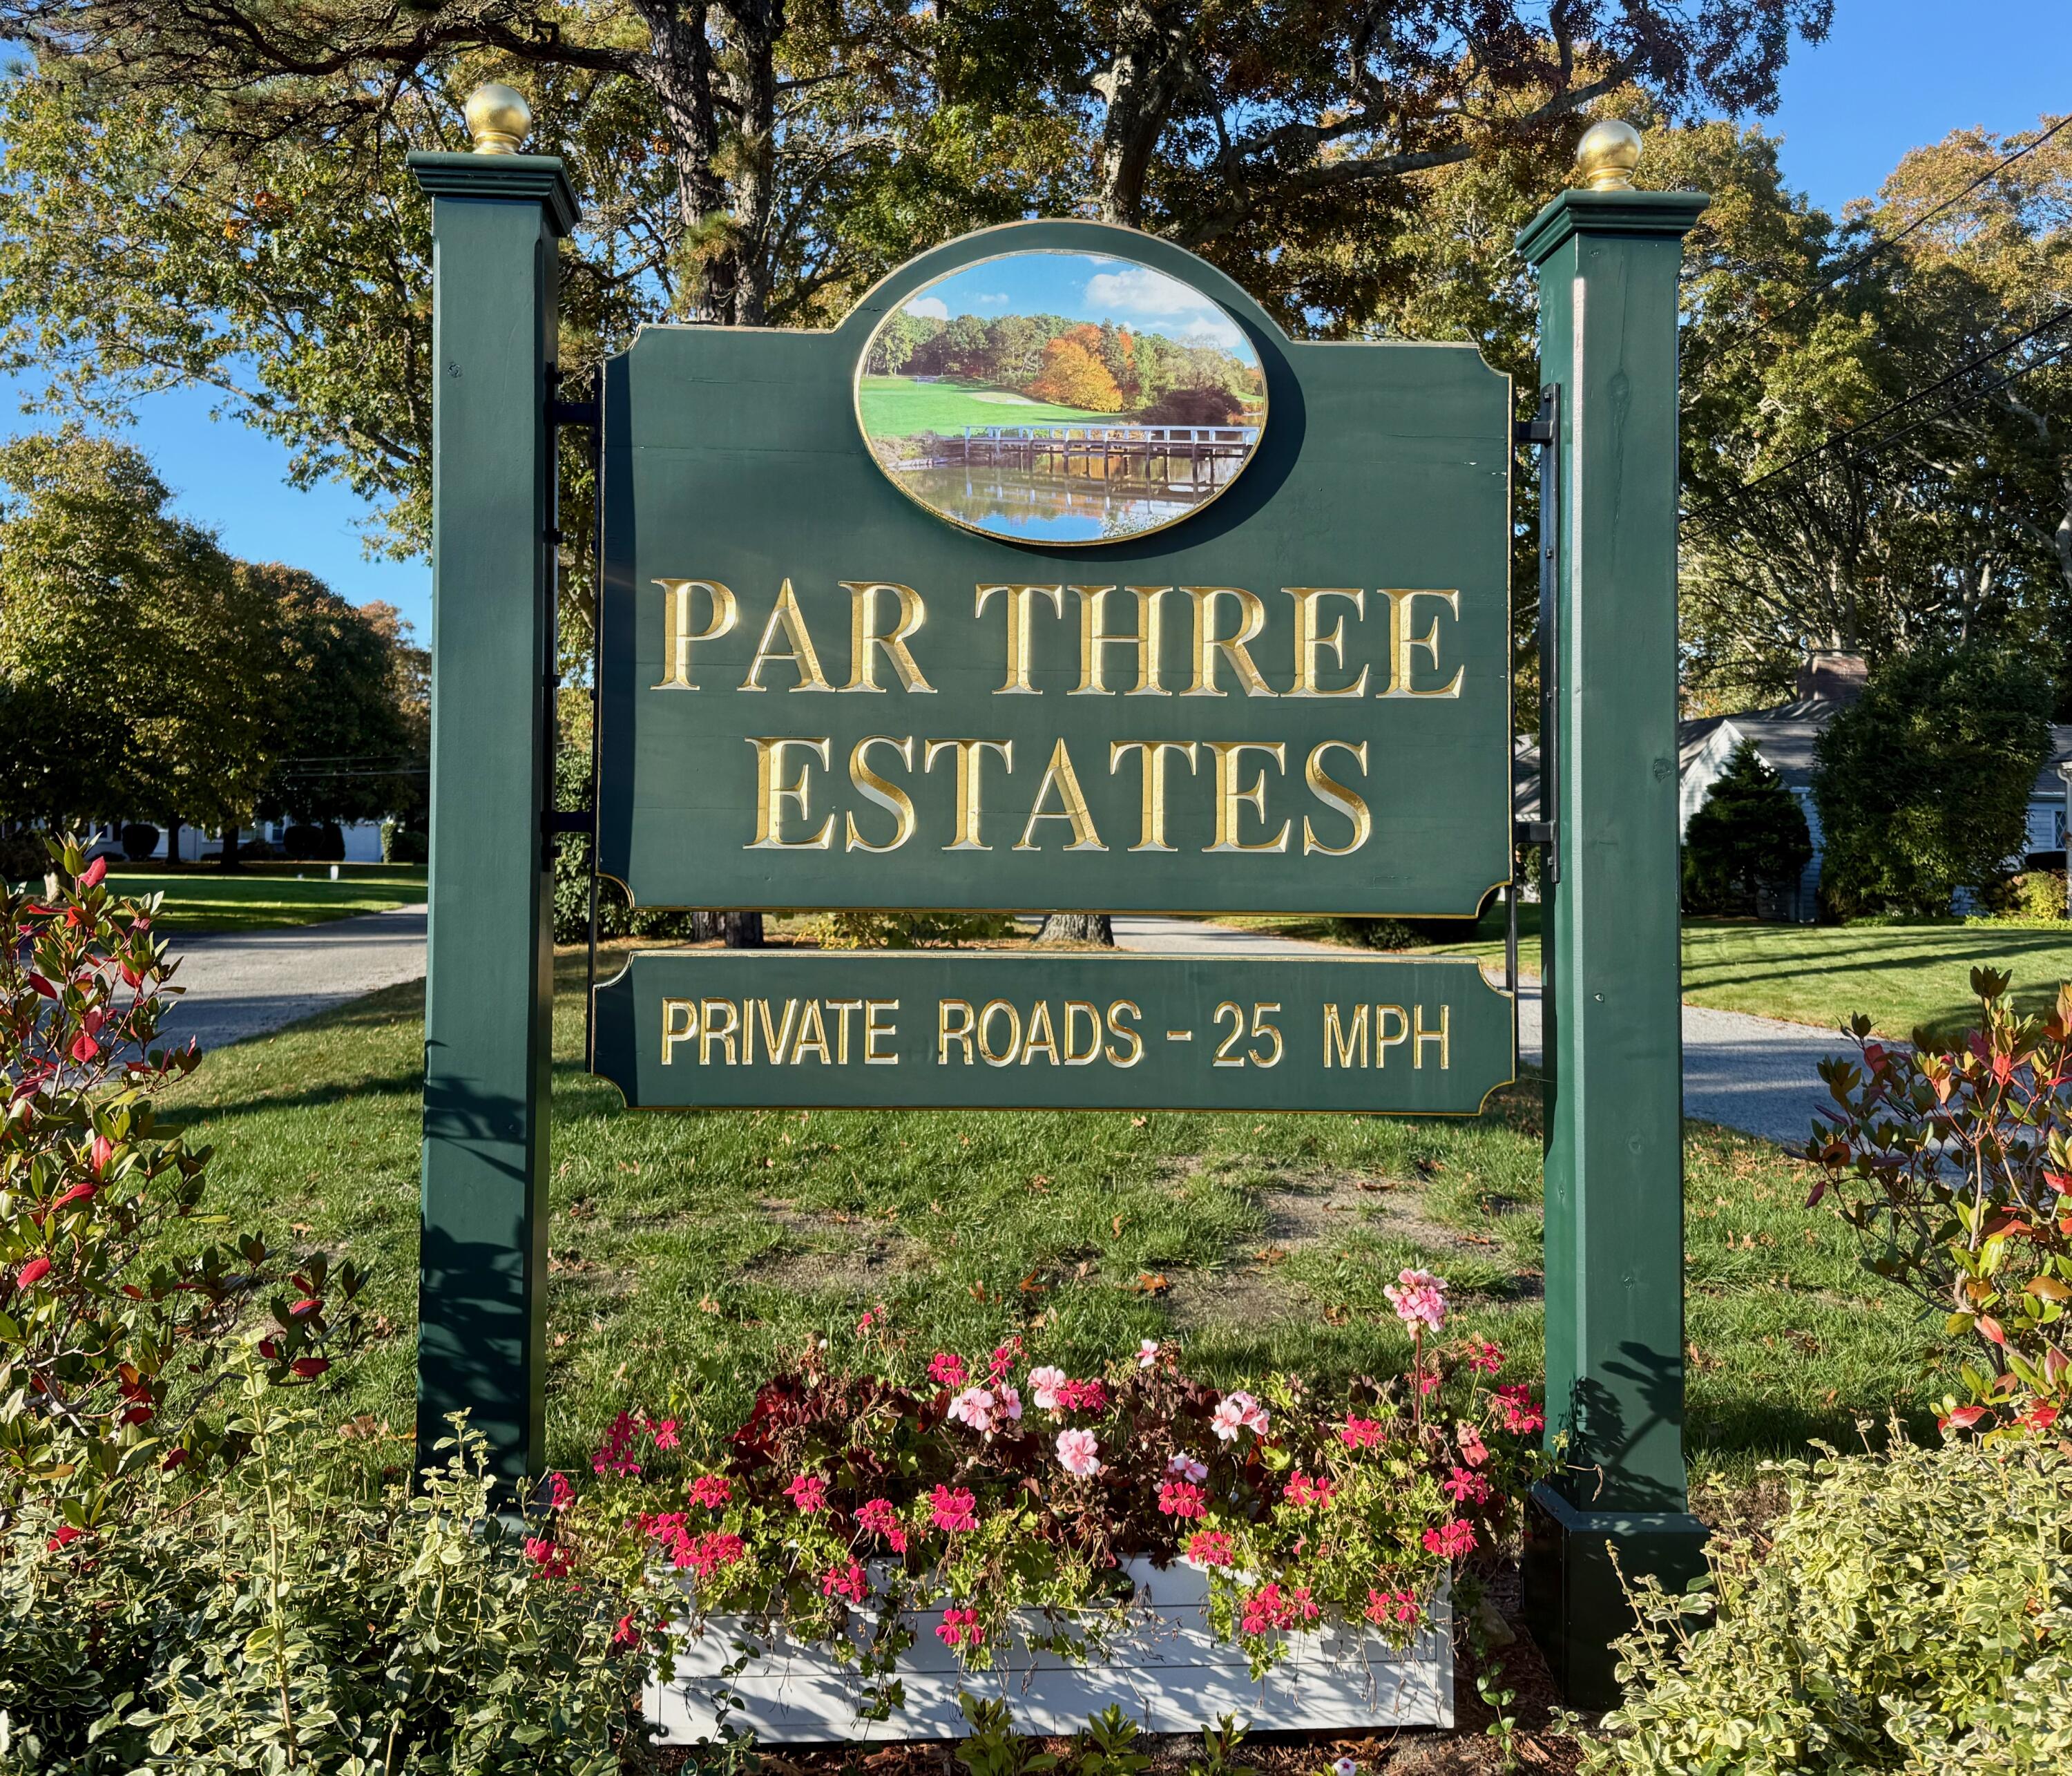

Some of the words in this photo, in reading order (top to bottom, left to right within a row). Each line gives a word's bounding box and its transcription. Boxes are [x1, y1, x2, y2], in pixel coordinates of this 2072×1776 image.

[651, 578, 937, 693] PAR
[975, 584, 1465, 698] THREE
[743, 736, 1372, 856] ESTATES
[660, 997, 899, 1065] PRIVATE
[938, 998, 1145, 1068] ROADS
[1166, 1030, 1193, 1042] -
[1213, 1001, 1283, 1068] 25
[1323, 1003, 1450, 1069] MPH
